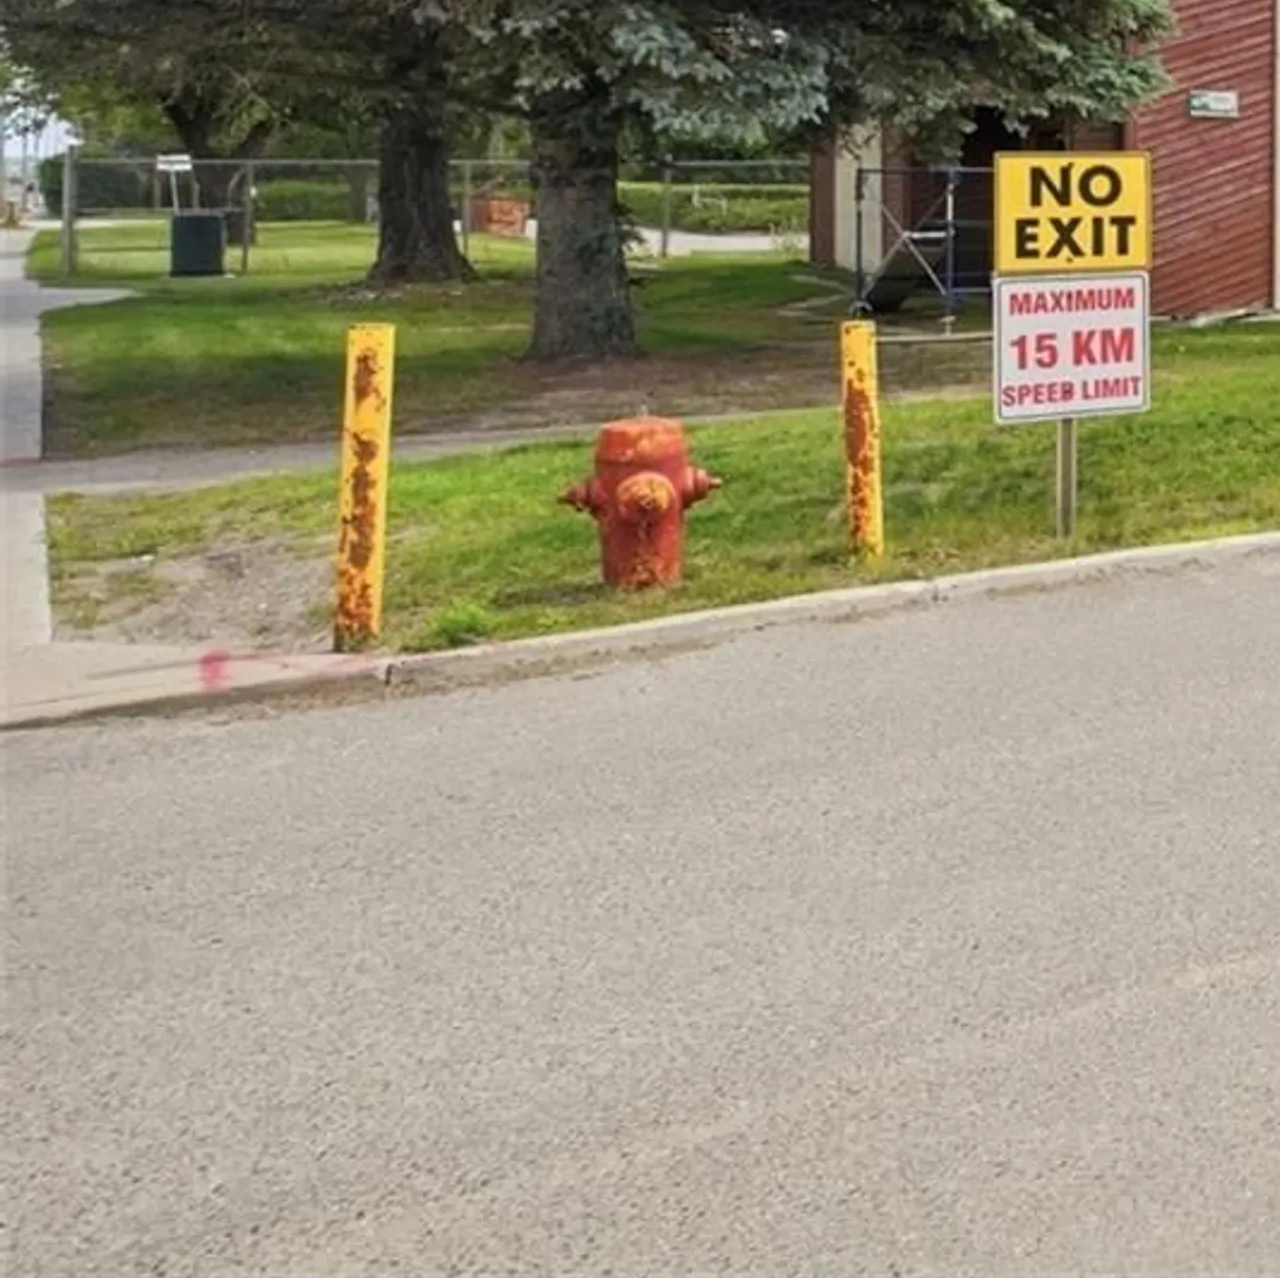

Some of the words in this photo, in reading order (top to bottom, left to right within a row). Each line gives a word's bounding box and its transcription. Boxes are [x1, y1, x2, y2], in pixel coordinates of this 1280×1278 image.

[1029, 162, 1121, 207] NO
[1015, 216, 1136, 260] EXIT
[1009, 287, 1135, 315] MAXIMUM
[1010, 333, 1058, 369] 15
[1073, 328, 1134, 366] KM
[1002, 381, 1074, 407] SPEED
[1082, 375, 1141, 400] LIMIT
